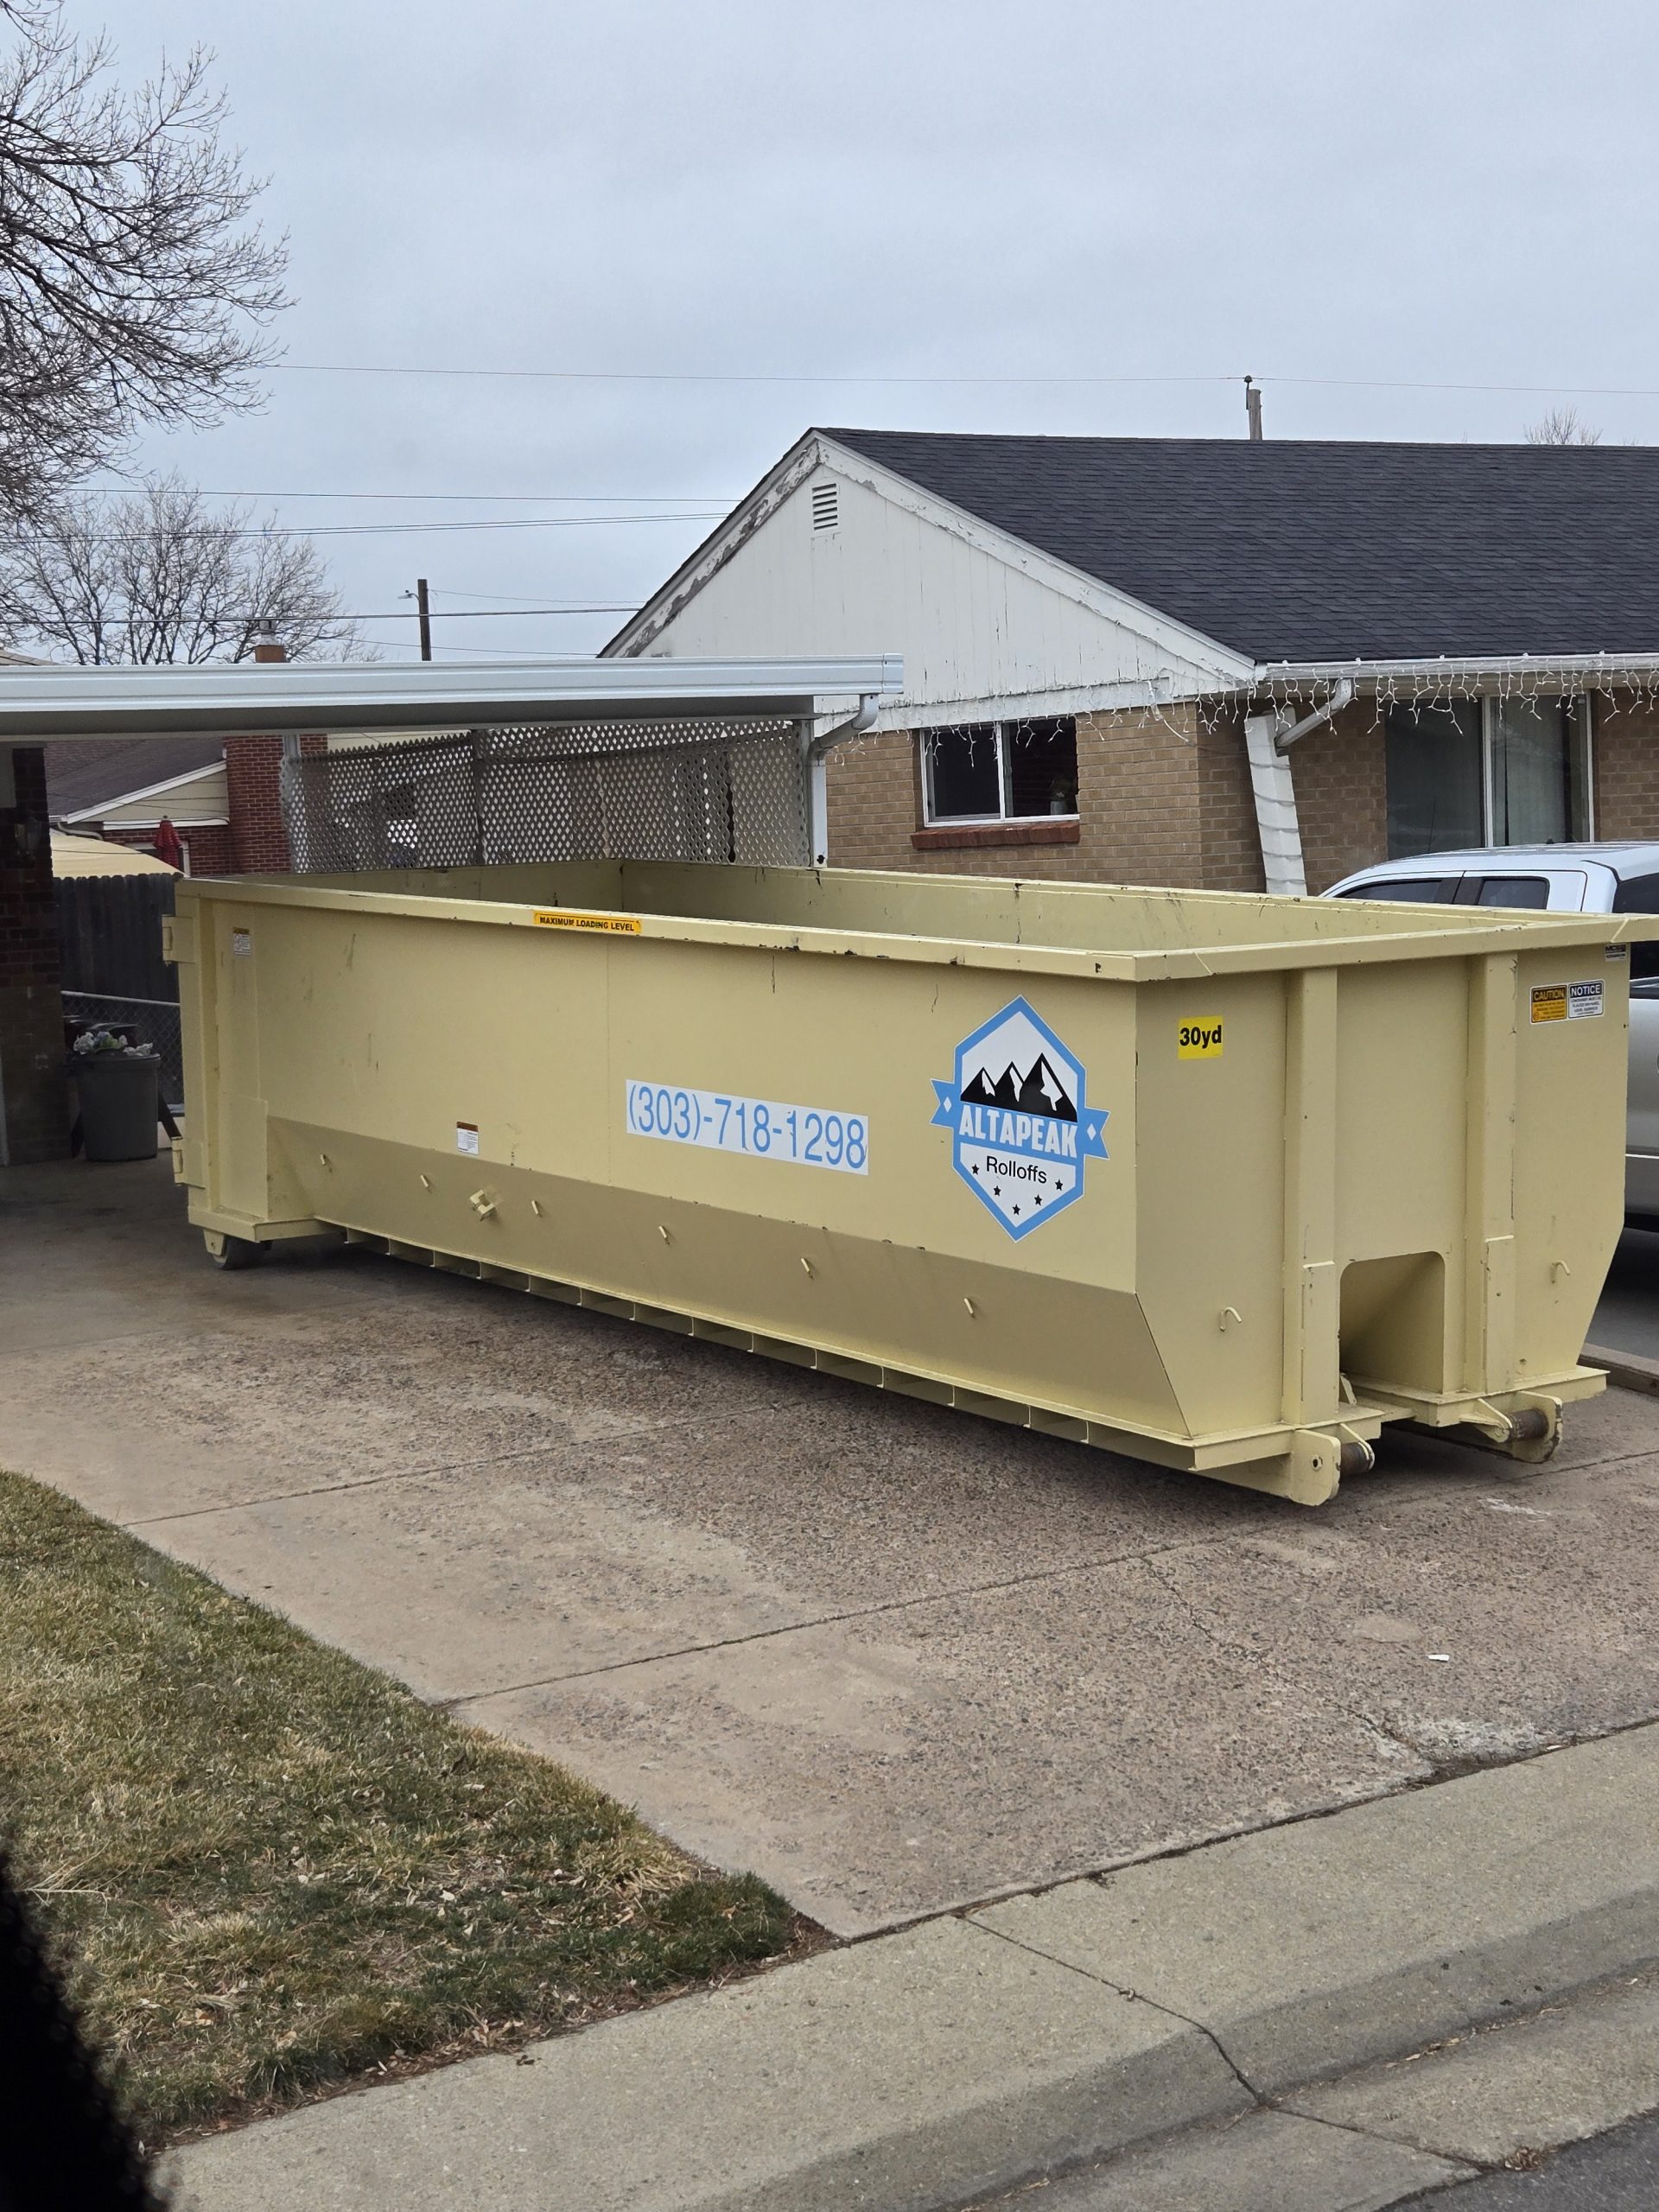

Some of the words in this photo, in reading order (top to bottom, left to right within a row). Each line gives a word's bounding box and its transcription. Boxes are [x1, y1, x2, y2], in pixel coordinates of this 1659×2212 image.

[539, 917, 574, 926] MAXIMUM
[576, 920, 608, 930] LOADING
[611, 923, 634, 931] LEVEL
[1534, 988, 1565, 1001] CAUTION
[1571, 984, 1601, 996] NOTICE
[1179, 1024, 1223, 1049] 30yd
[630, 1084, 865, 1169] (303)-718-1298
[959, 1104, 1077, 1159] ALTAPEAK
[986, 1155, 1047, 1184] Rolloffs
